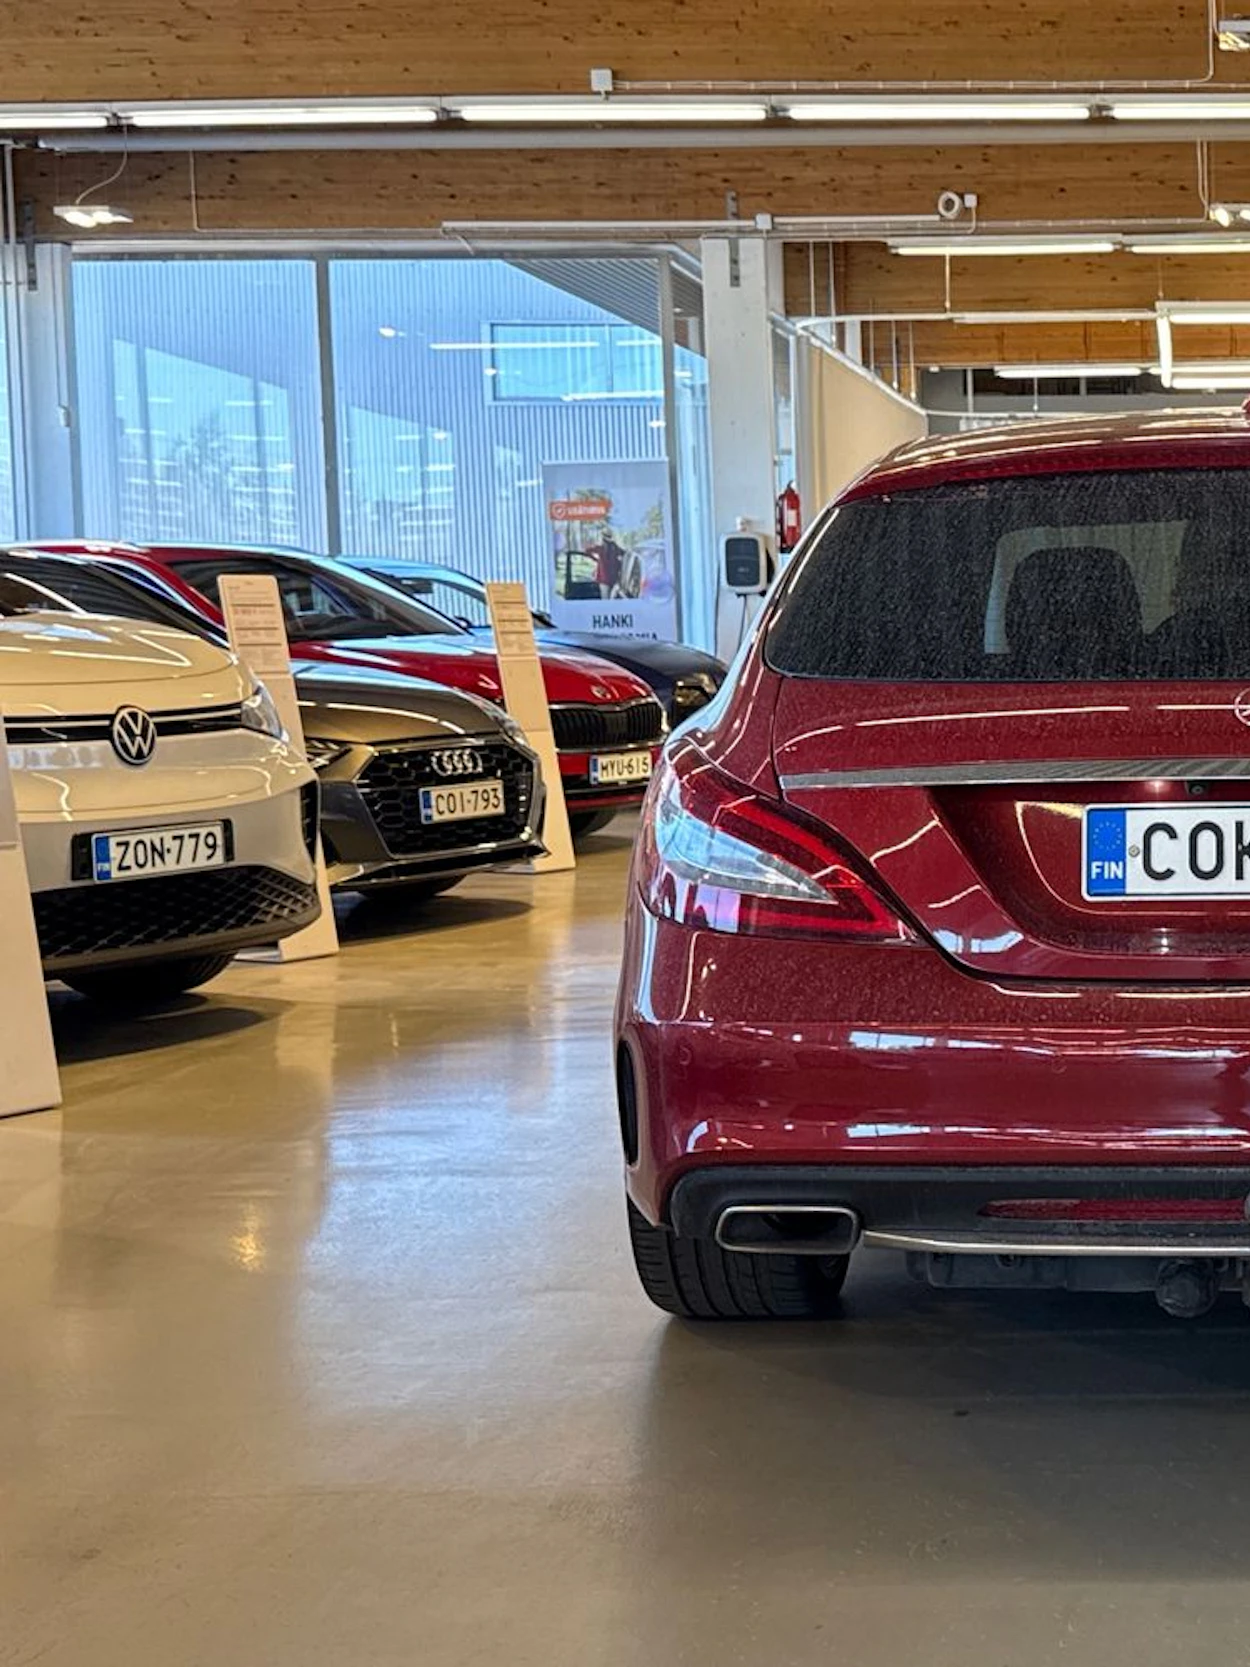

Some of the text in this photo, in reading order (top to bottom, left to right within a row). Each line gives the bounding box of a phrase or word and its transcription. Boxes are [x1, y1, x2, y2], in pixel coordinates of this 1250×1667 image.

[592, 614, 634, 629] HANKI
[601, 757, 649, 778] MYU-615
[435, 787, 500, 815] COI-793
[115, 831, 218, 872] ZON-779
[1090, 861, 1124, 881] FIN
